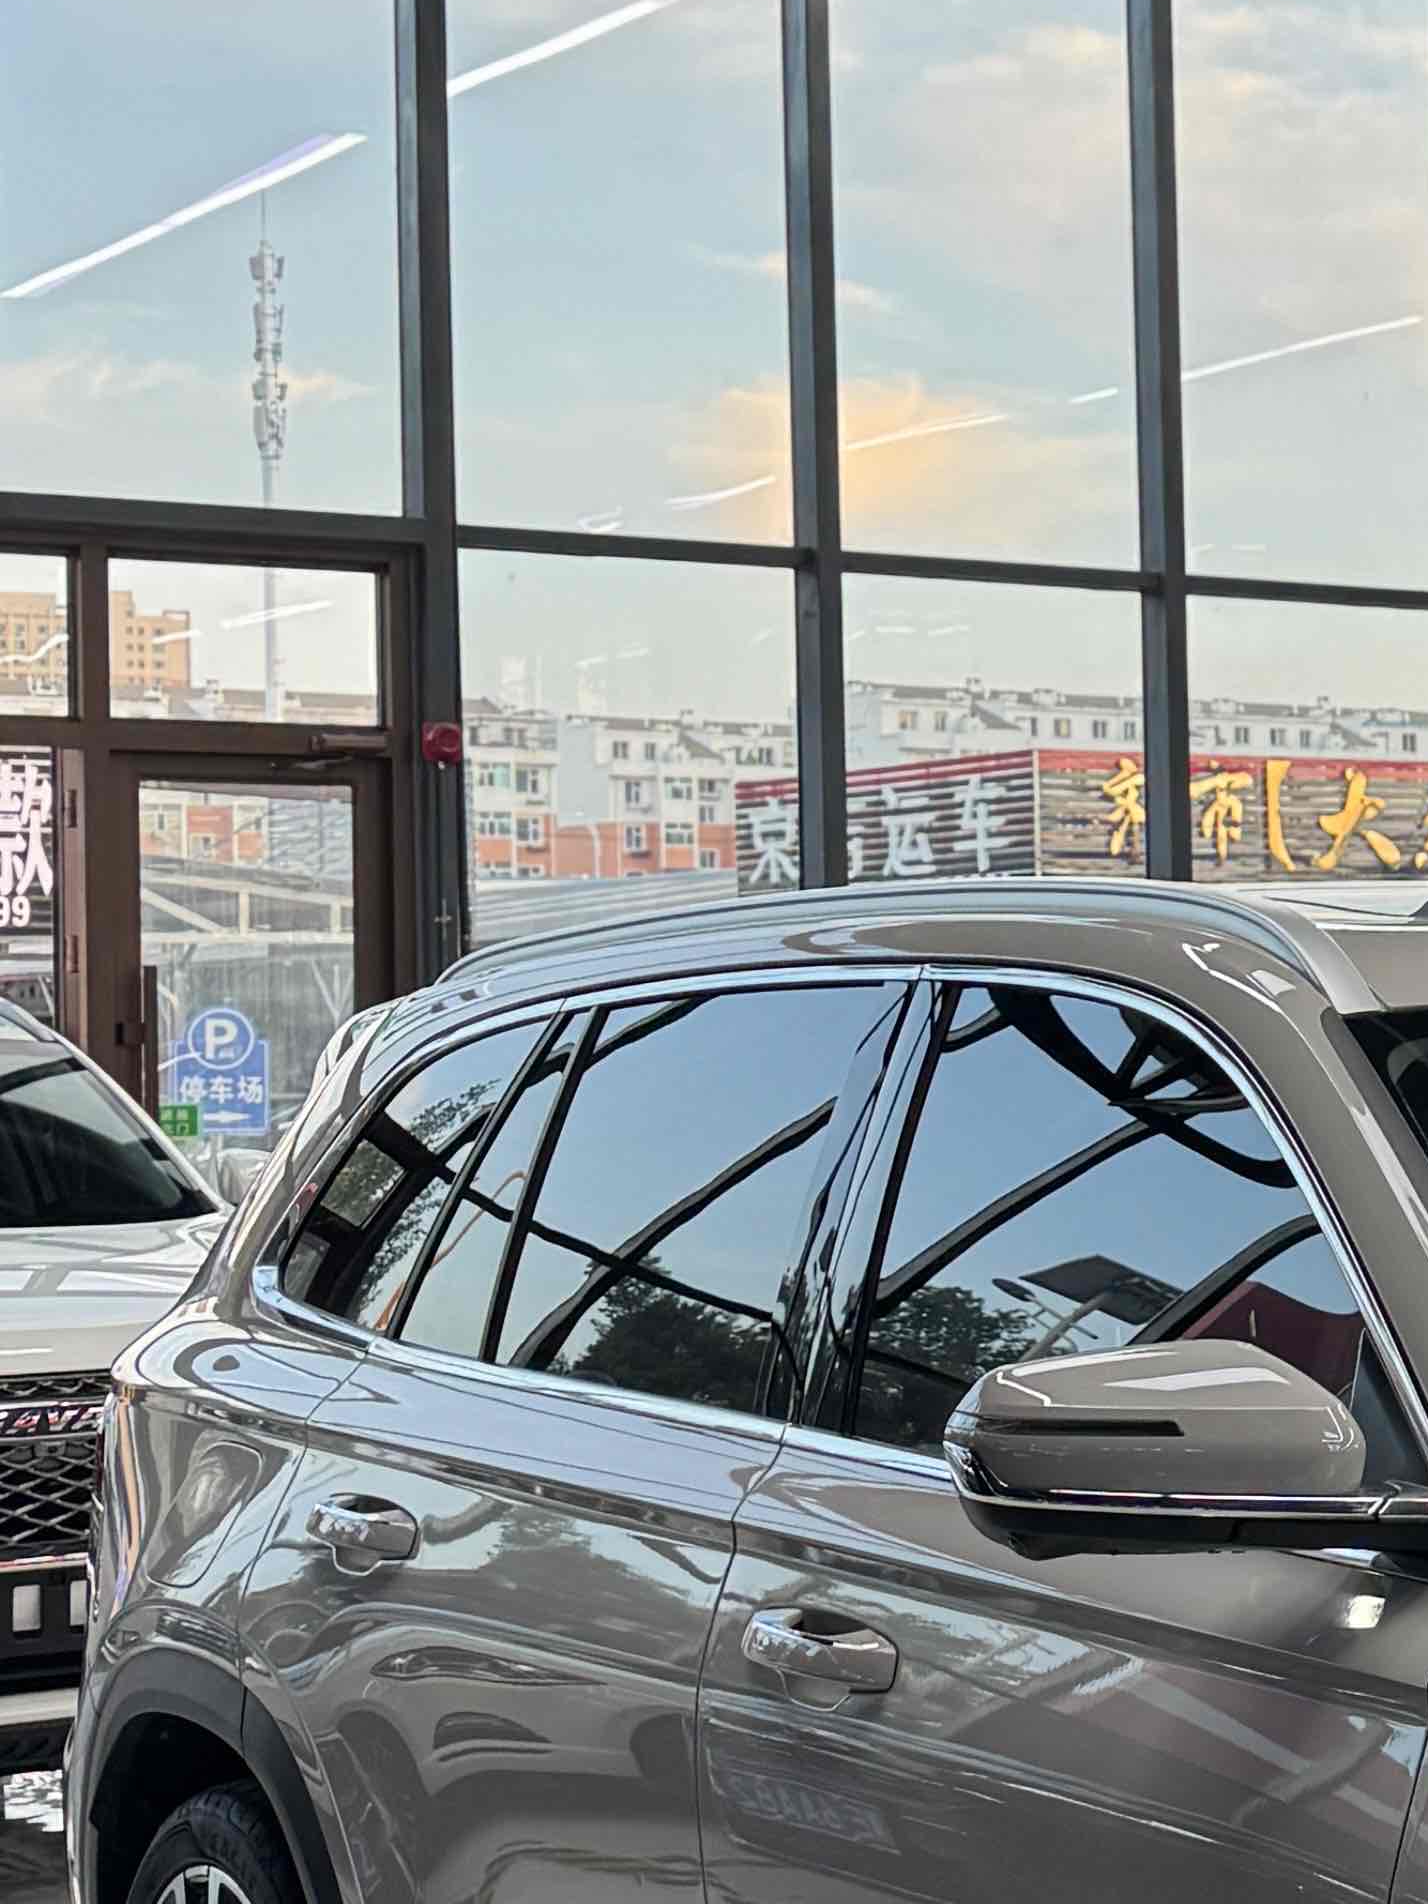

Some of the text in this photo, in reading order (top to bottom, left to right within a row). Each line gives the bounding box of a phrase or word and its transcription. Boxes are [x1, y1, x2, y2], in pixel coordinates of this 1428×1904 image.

[204, 1017, 238, 1060] P
[179, 1074, 264, 1105] 停车场
